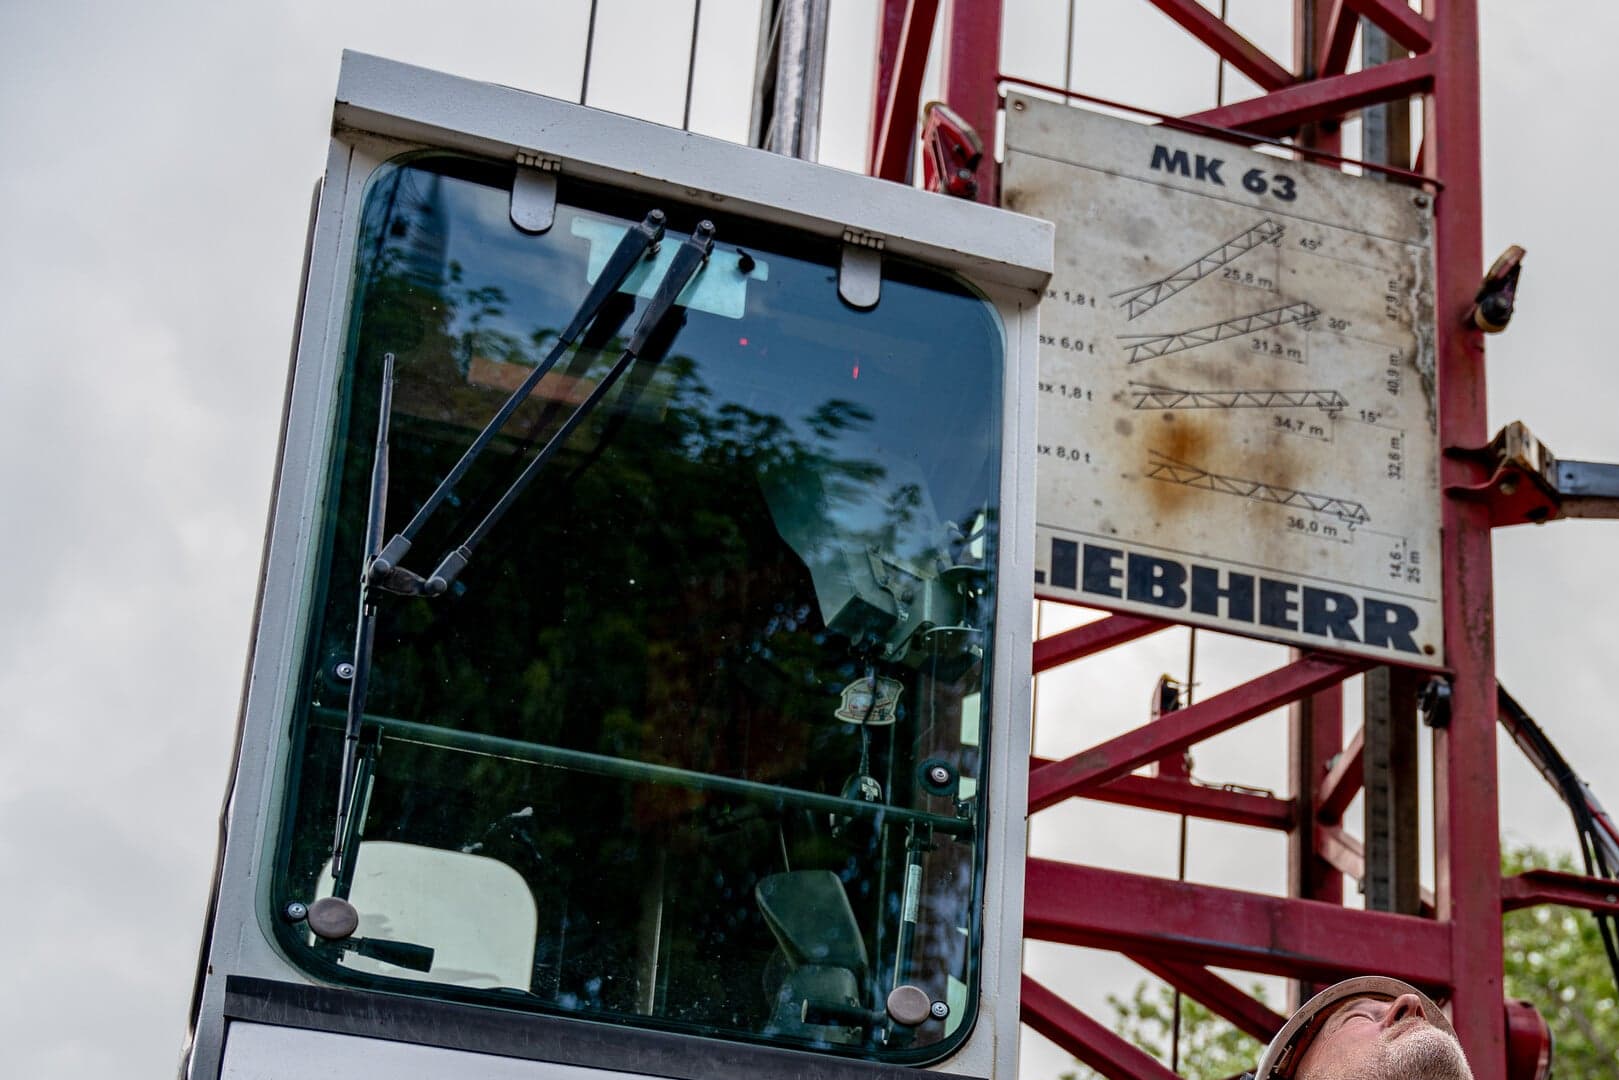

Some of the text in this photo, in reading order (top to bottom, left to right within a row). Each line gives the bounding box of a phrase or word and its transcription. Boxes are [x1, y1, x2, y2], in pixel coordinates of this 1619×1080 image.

[1150, 144, 1298, 203] MK 63
[1223, 267, 1273, 289] 25,8 m
[1060, 336, 1085, 352] 6,0
[1088, 343, 1095, 355] t
[1287, 348, 1302, 360] m
[1389, 354, 1400, 367] m
[1060, 383, 1083, 400] 1,8
[1086, 390, 1093, 402] t
[1272, 414, 1324, 436] 34,7 m
[1390, 436, 1402, 447] m
[1056, 445, 1081, 462] 8,0
[1084, 452, 1091, 464] t
[1286, 515, 1338, 537] 36,0 m
[1389, 551, 1403, 580] 14,6
[1406, 551, 1422, 584] 25 m
[1035, 536, 1422, 656] IEBHERR
